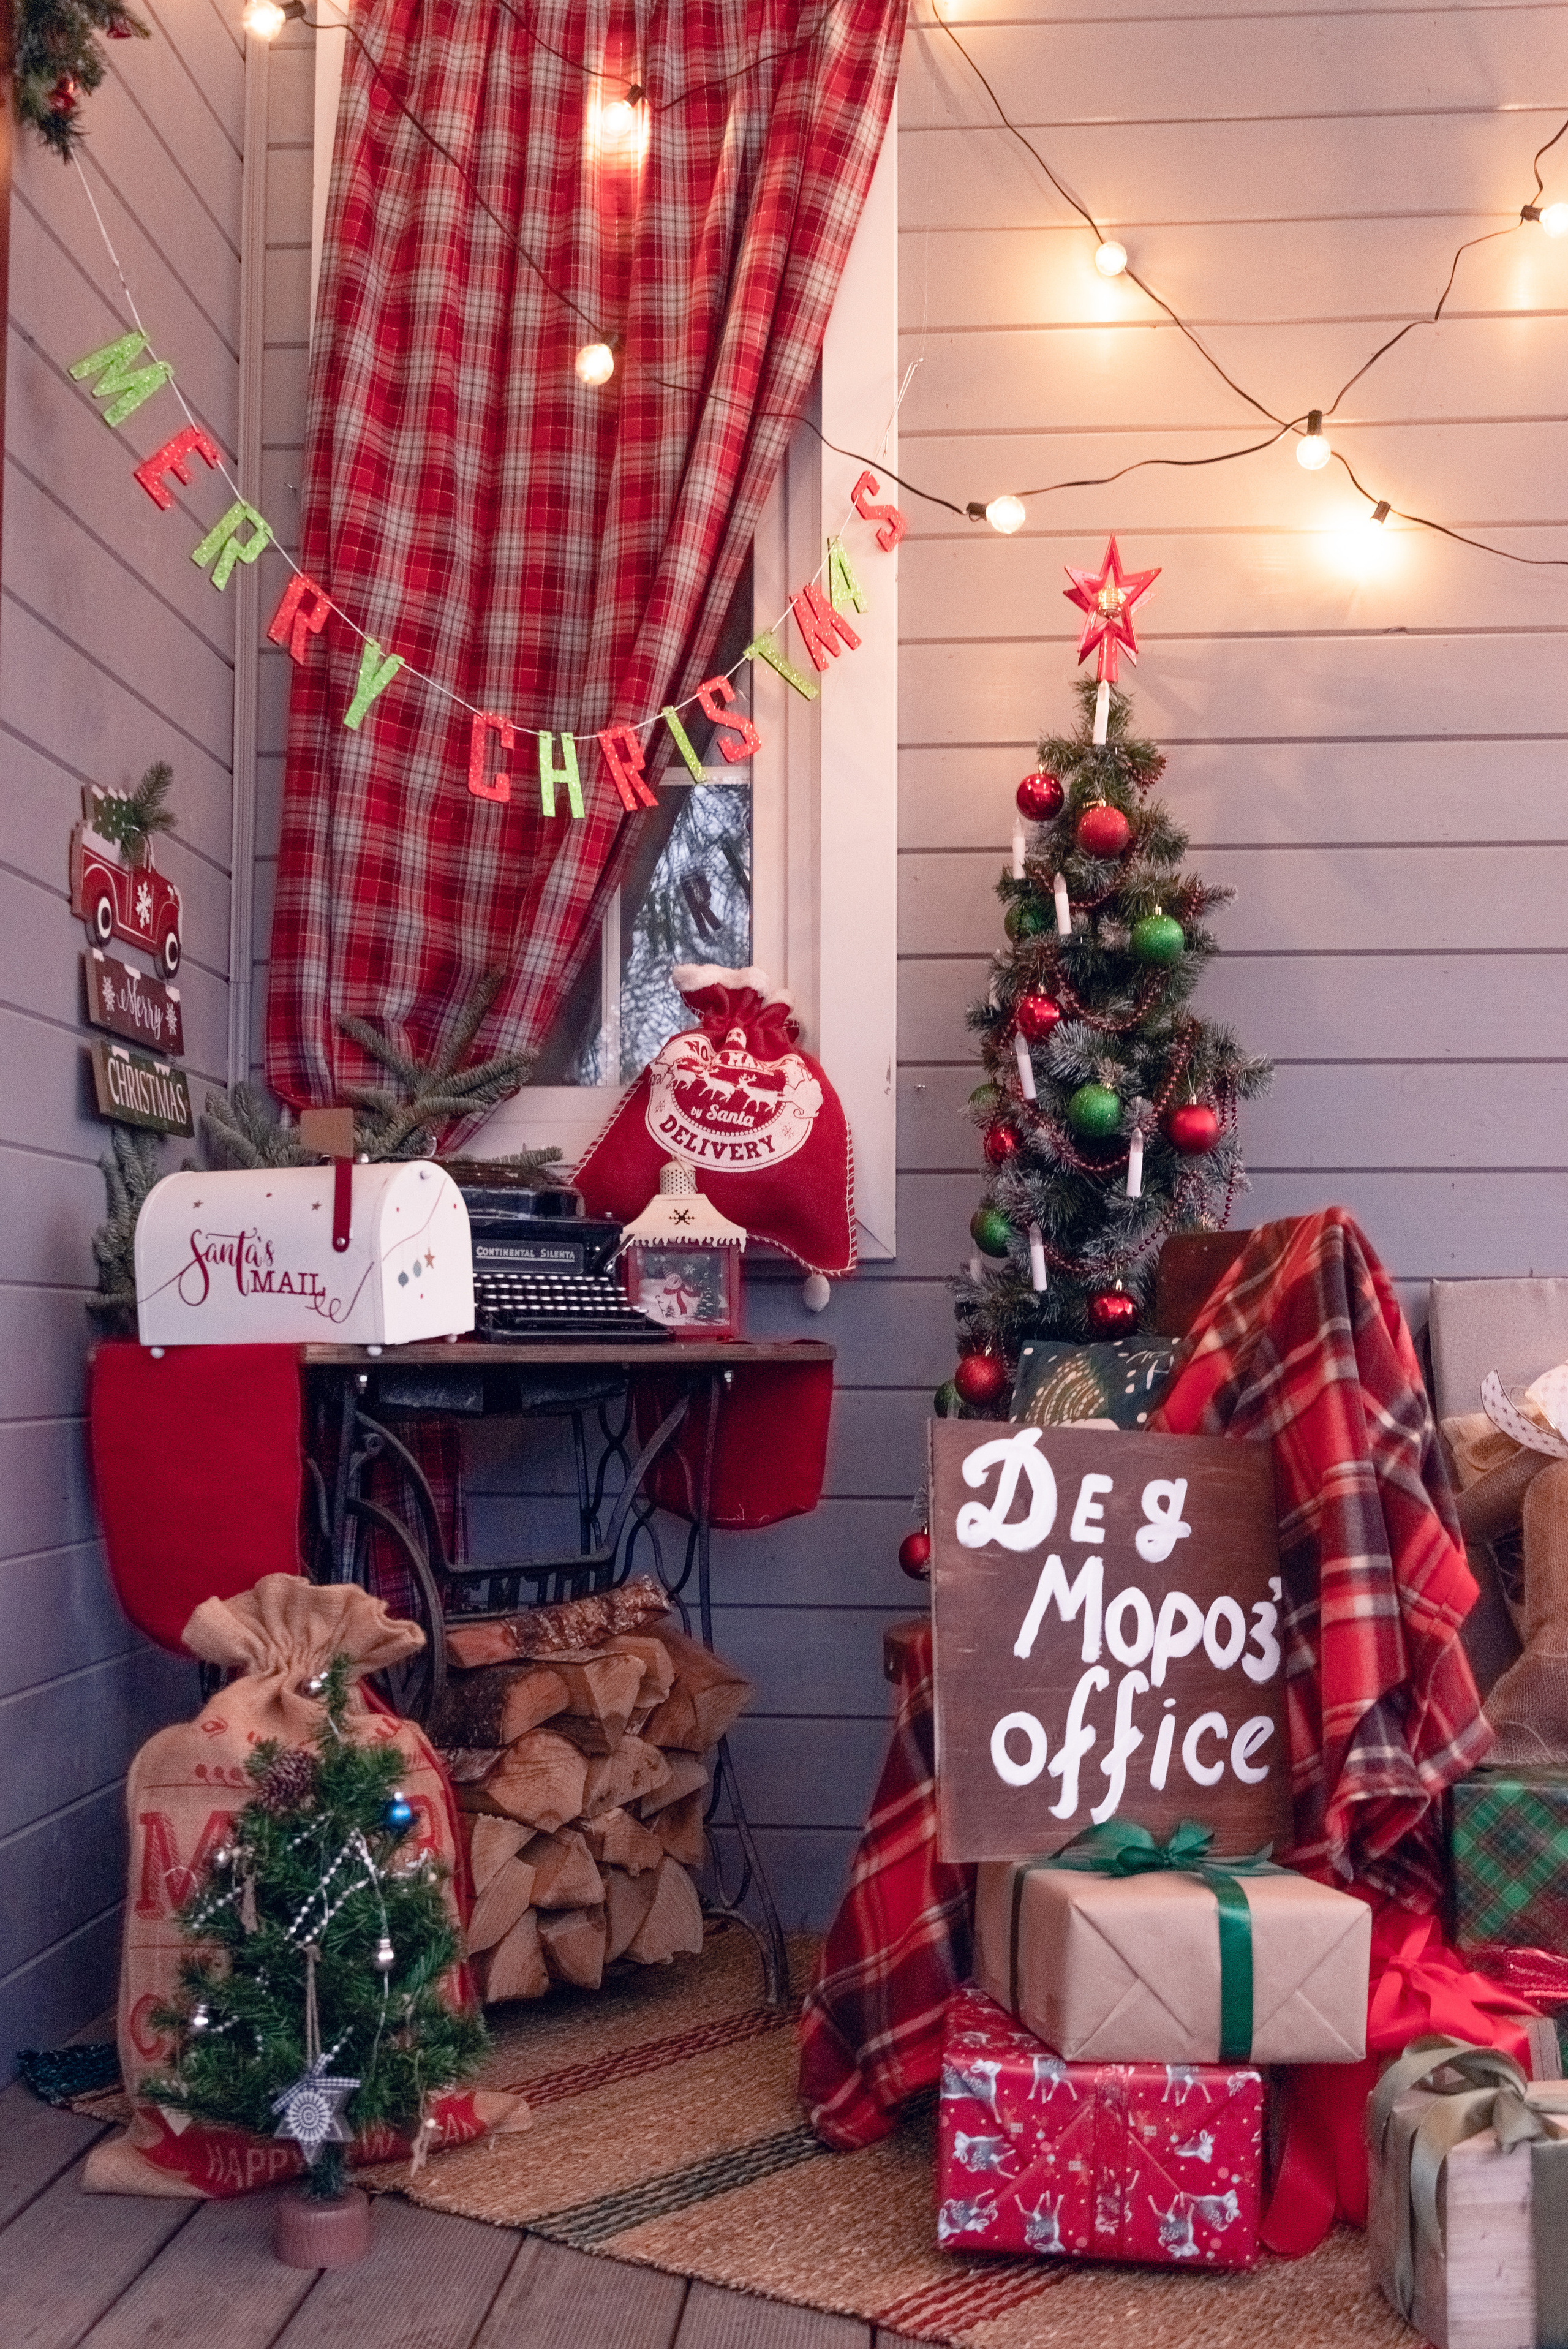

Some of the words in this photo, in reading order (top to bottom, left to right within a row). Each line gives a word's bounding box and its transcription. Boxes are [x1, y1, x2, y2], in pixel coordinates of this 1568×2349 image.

[69, 331, 404, 730] MERRY
[468, 470, 907, 818] CHRISTMAS
[115, 978, 164, 1040] Merry
[108, 1057, 187, 1125] CHRISTMAS
[691, 1106, 703, 1119] by
[706, 1104, 755, 1126] Santa
[659, 1114, 776, 1161] DELIVERY
[178, 1227, 276, 1306] Santa's
[249, 1270, 326, 1297] MAIL
[990, 1665, 1274, 1825] office
